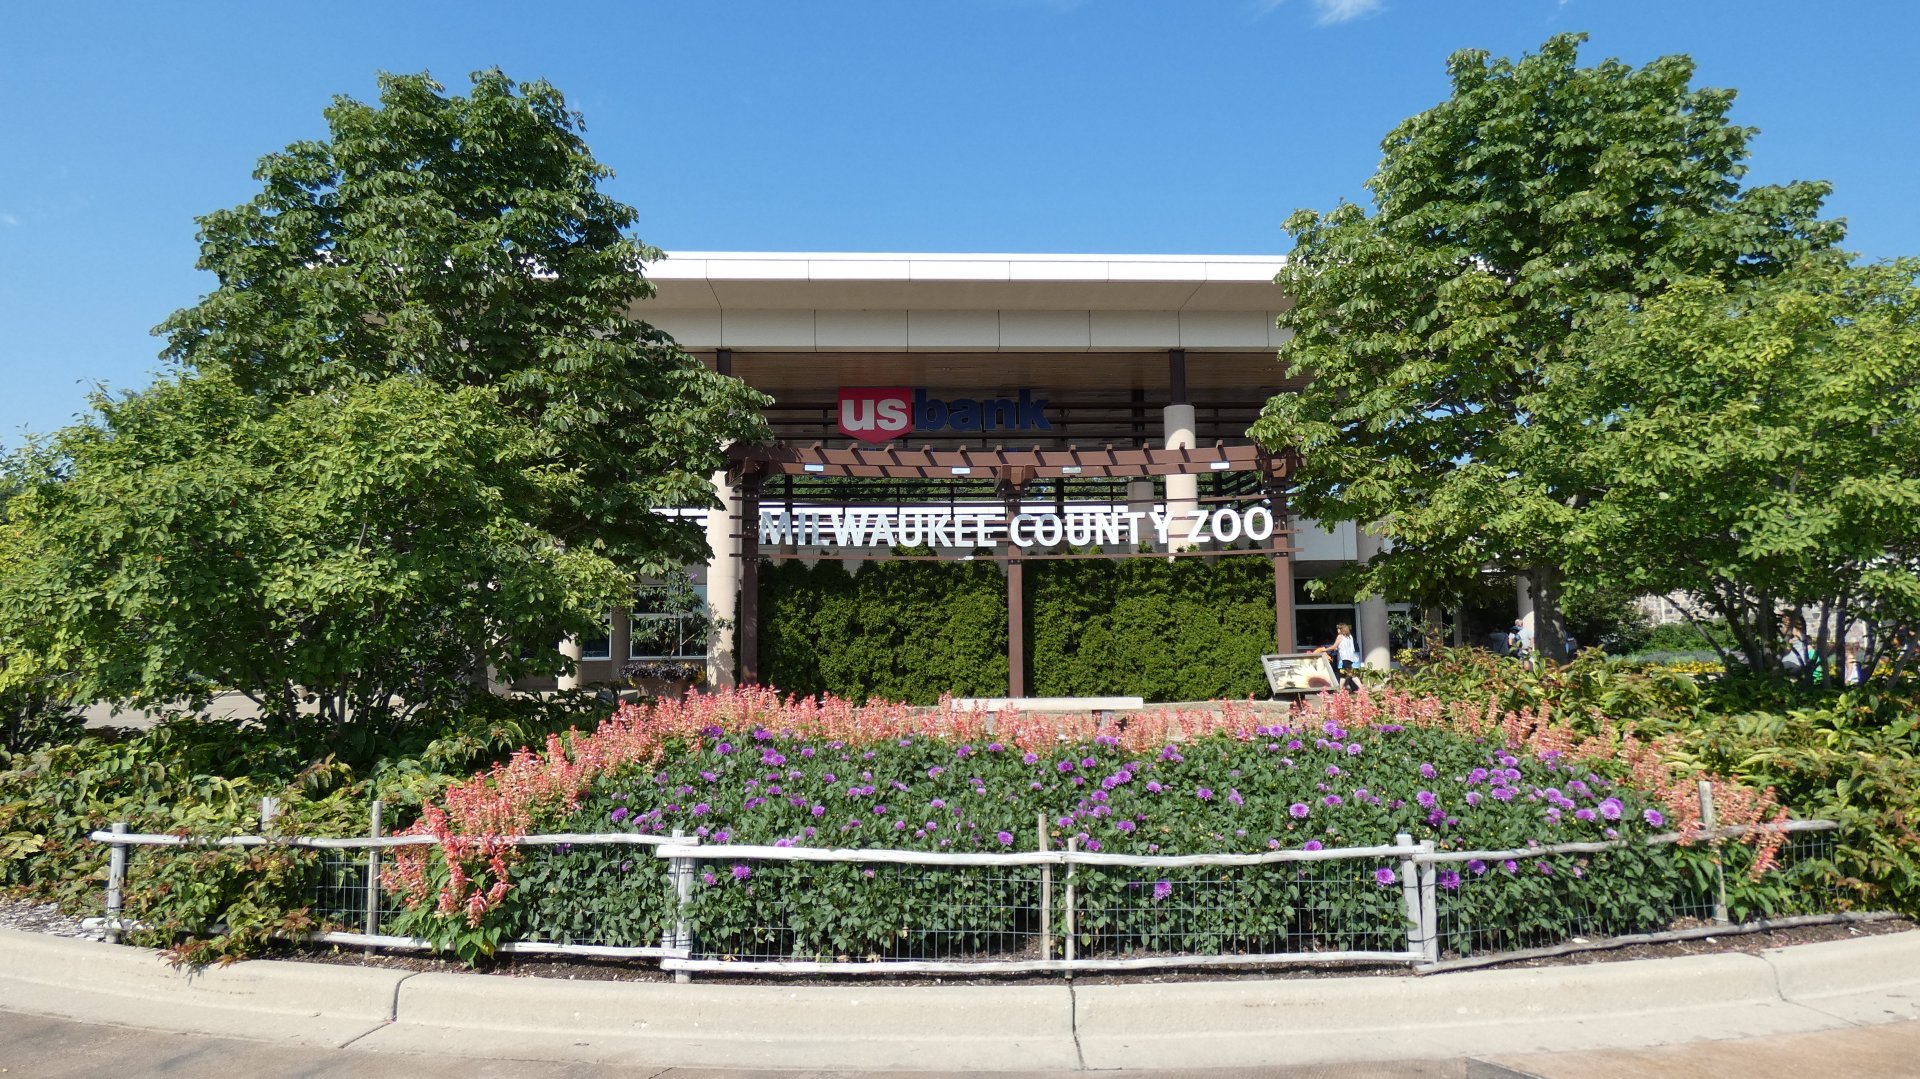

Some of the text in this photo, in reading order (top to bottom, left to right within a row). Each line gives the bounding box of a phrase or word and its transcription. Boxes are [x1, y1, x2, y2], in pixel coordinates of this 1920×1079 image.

[758, 506, 1275, 548] MILWAUKEE COUNTY ZOO
